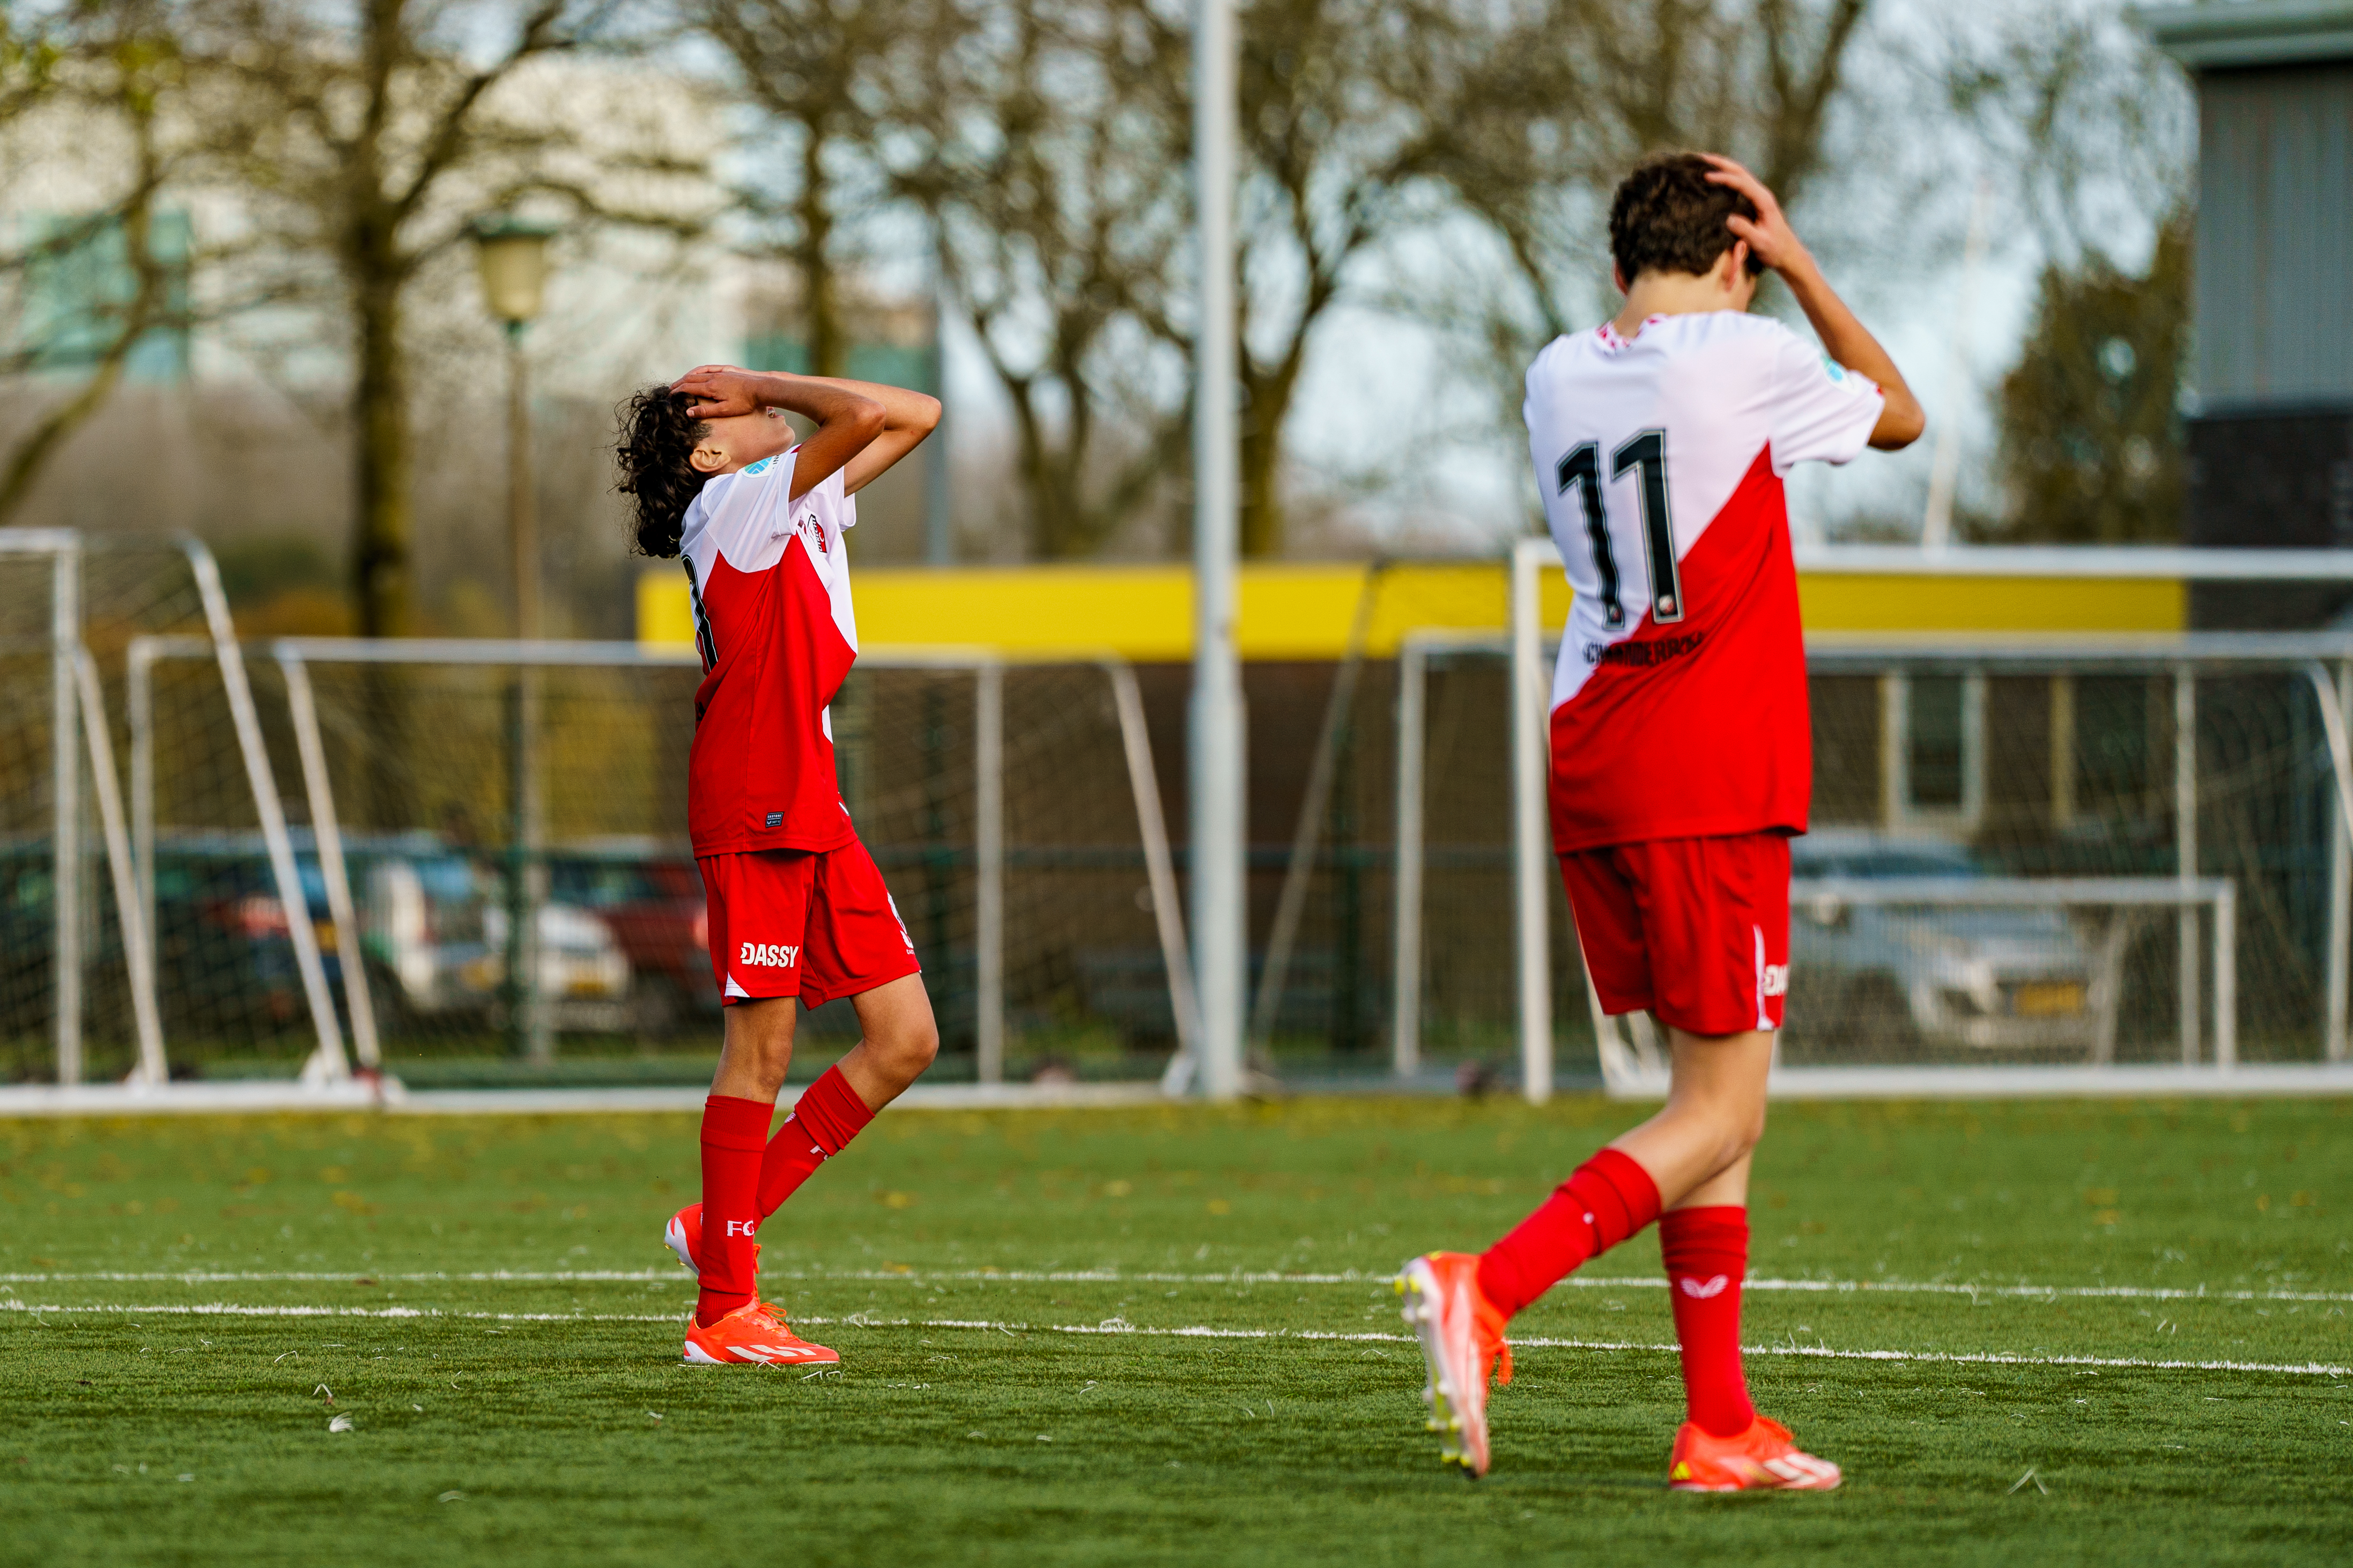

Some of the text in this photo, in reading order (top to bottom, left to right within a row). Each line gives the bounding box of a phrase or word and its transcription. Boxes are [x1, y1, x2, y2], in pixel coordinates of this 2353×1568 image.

[1556, 427, 1684, 631] 11
[740, 942, 799, 968] DASSY
[727, 1220, 755, 1237] FC
